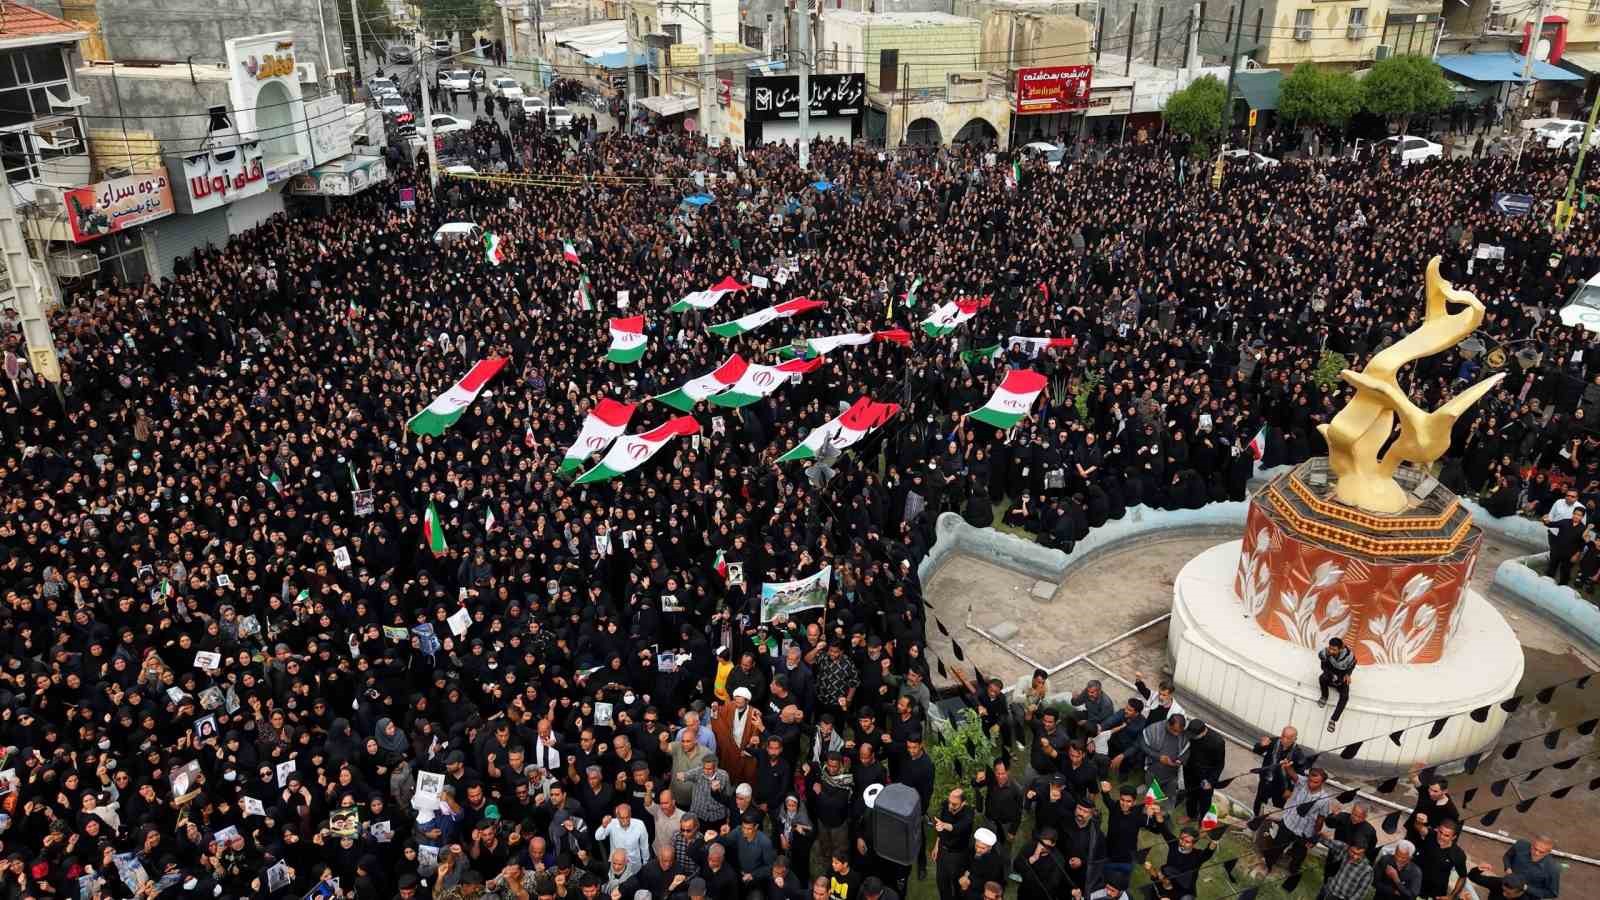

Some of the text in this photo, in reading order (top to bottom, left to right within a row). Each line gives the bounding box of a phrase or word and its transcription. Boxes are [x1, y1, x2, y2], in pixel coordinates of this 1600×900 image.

[808, 82, 831, 107] موبایل
[832, 76, 862, 105] فروشگاه
[102, 183, 135, 209] سرای
